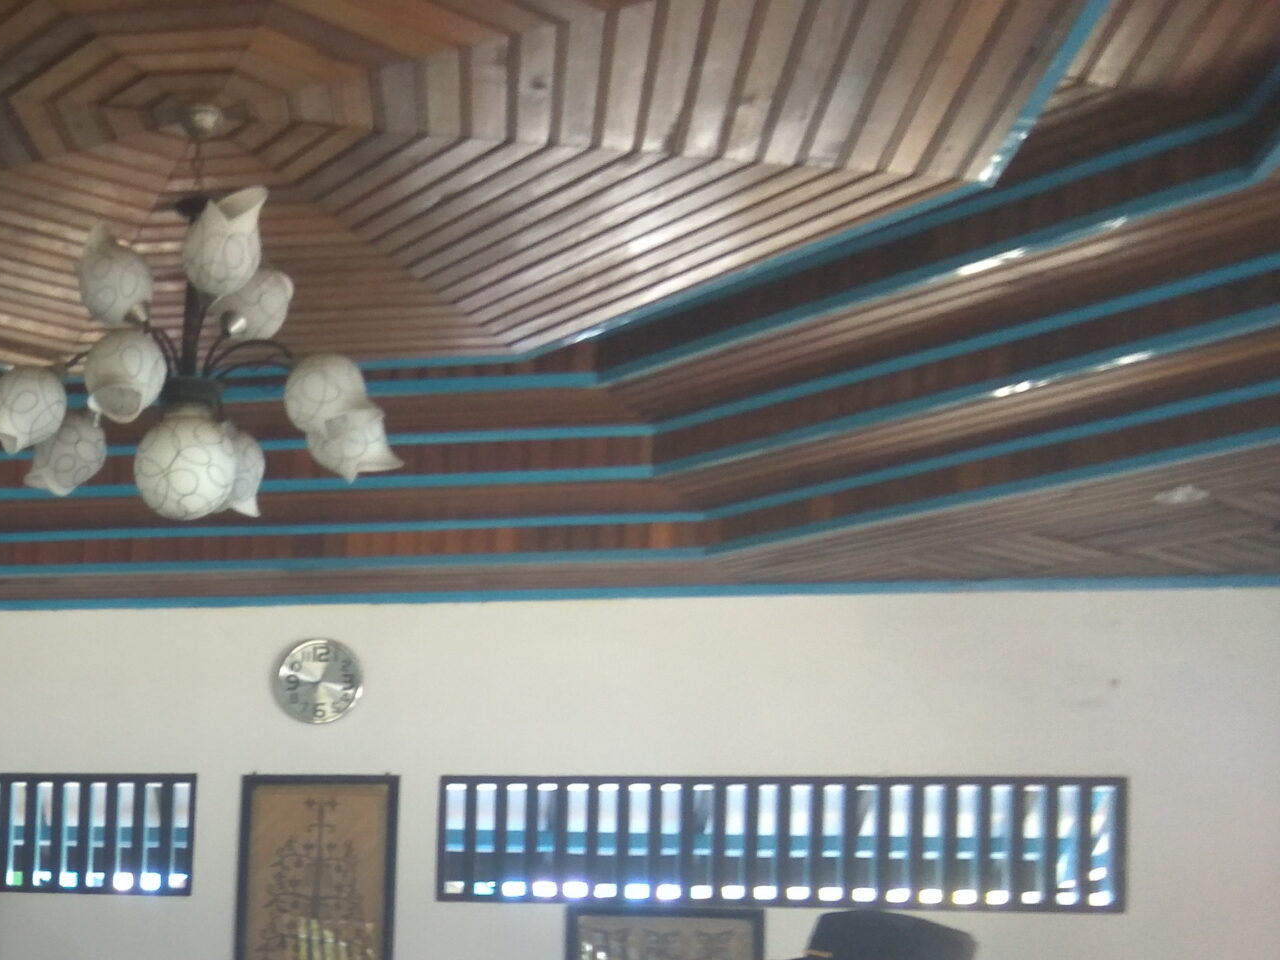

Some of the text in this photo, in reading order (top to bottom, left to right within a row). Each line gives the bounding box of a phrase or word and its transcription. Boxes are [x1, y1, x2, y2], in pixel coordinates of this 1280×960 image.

[312, 645, 330, 663] 12
[285, 674, 300, 691] 9
[341, 673, 355, 691] 3
[312, 702, 327, 719] 6
